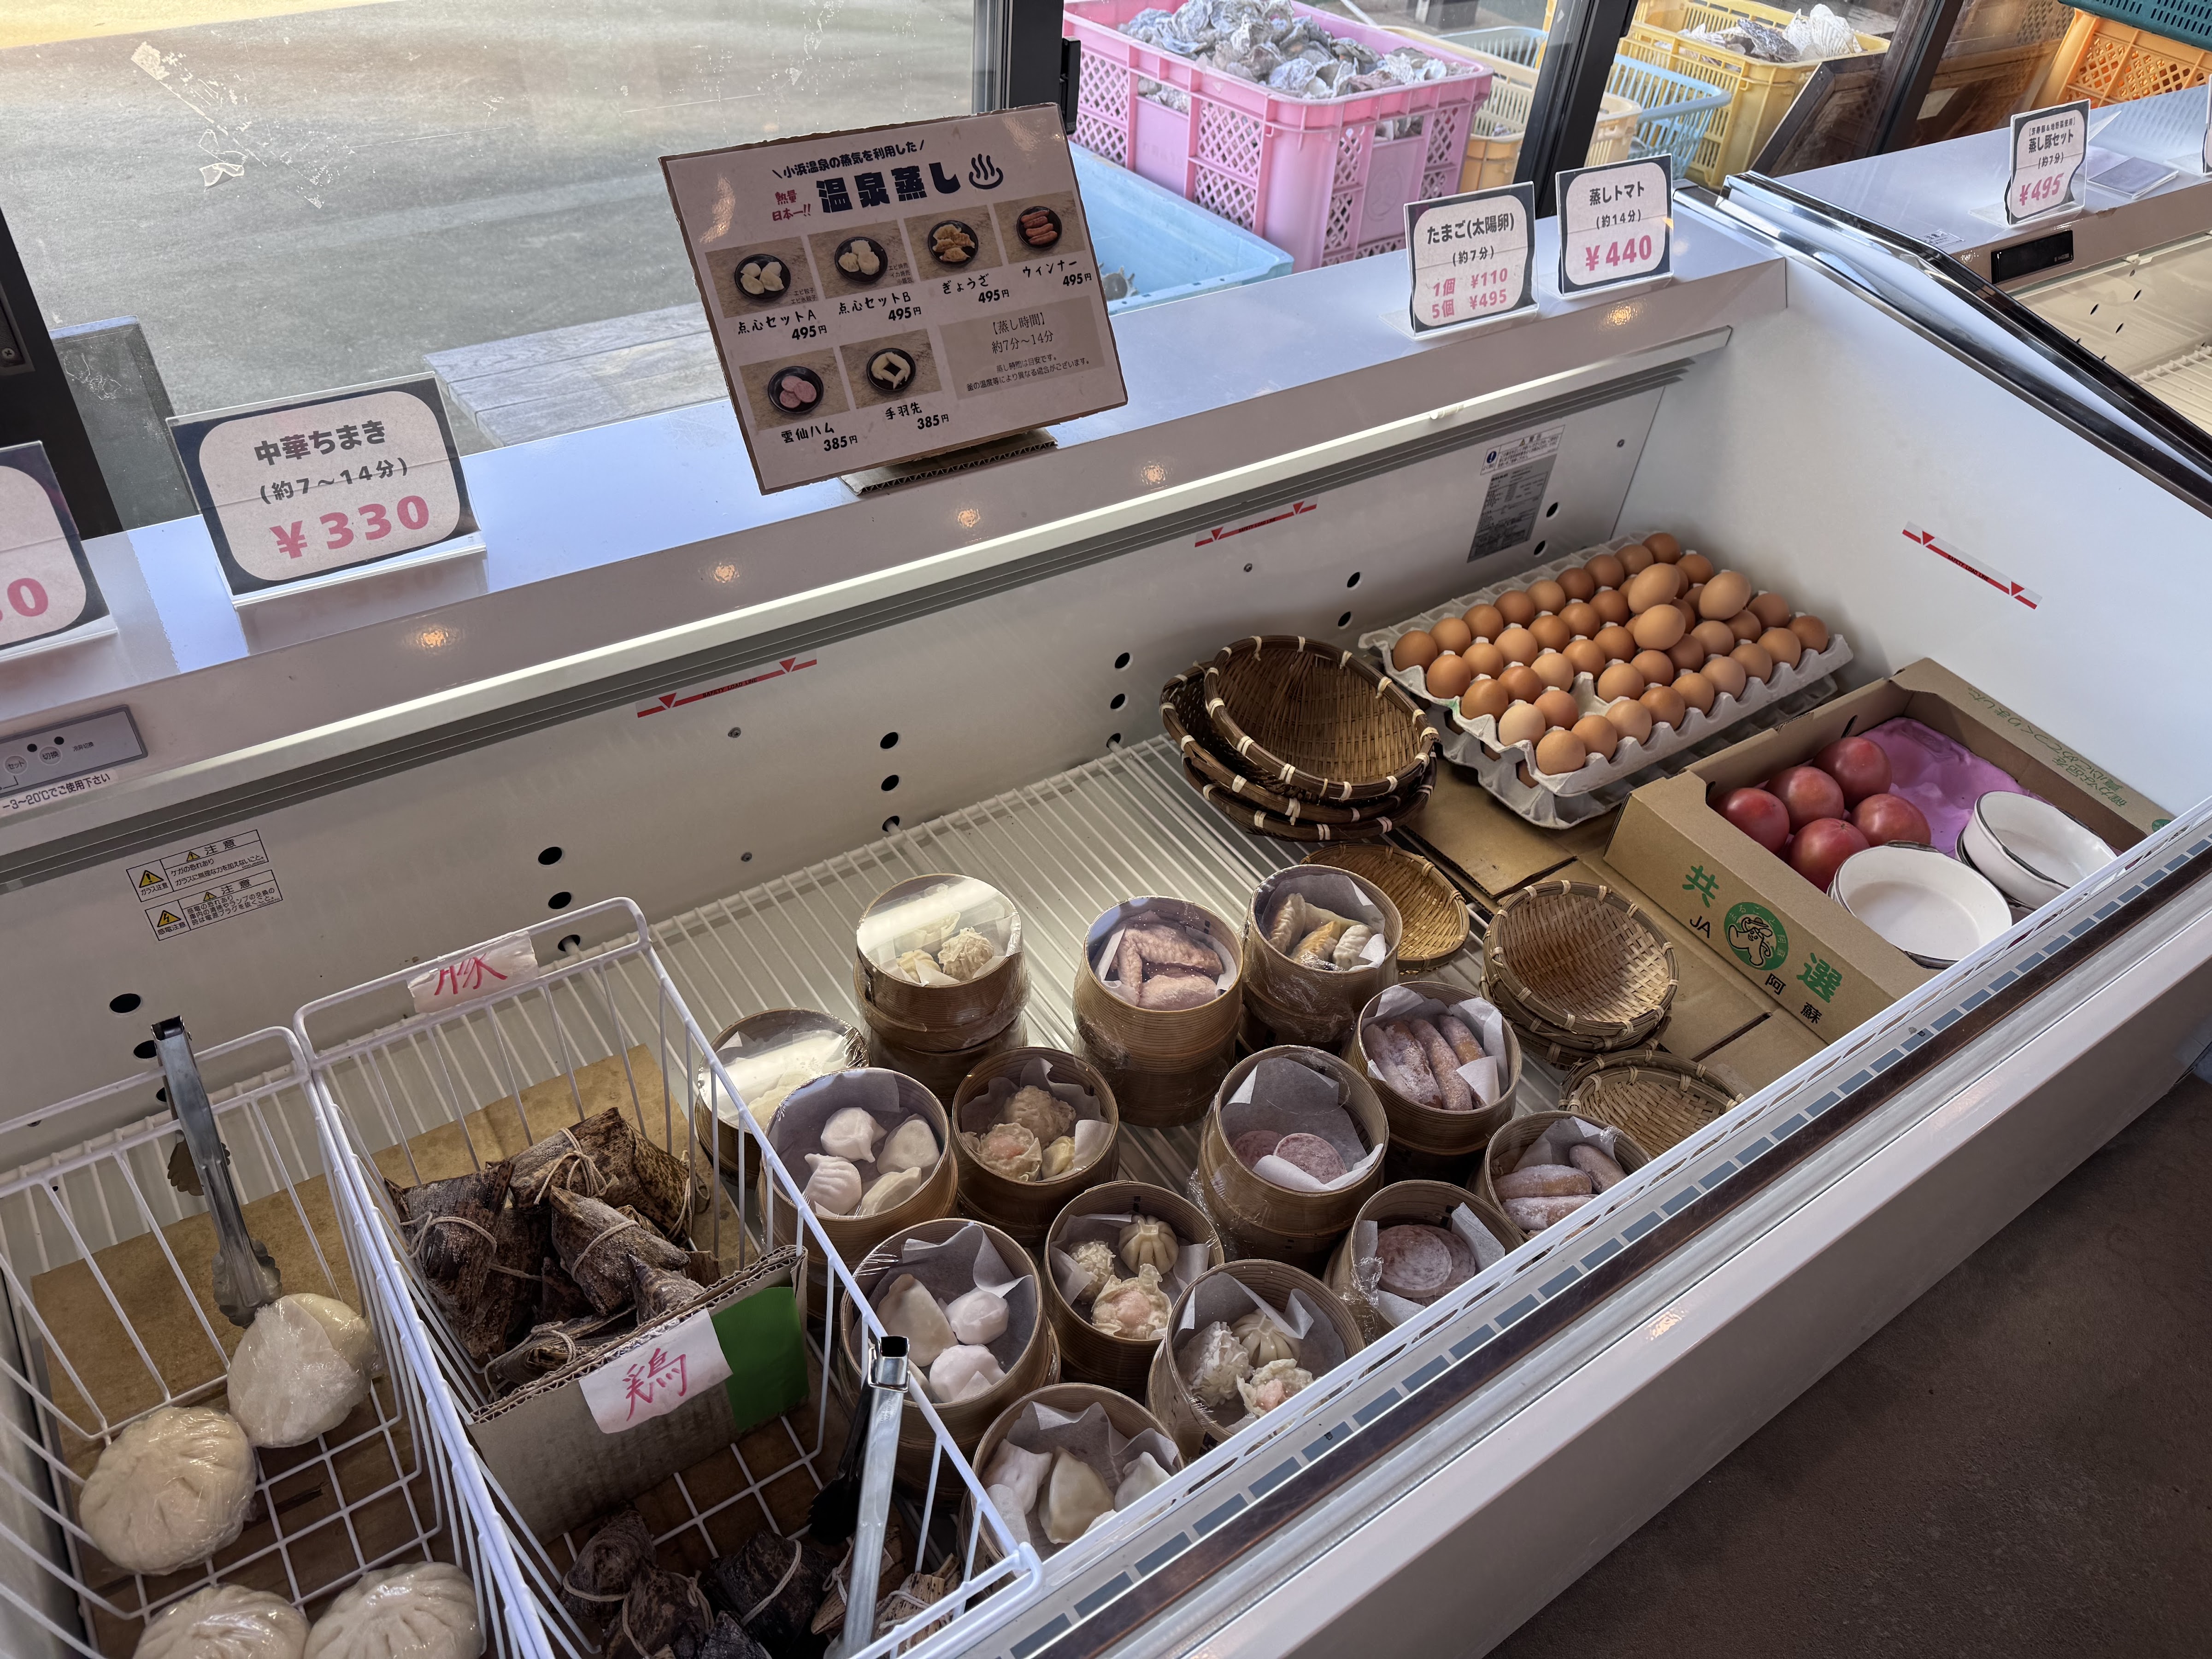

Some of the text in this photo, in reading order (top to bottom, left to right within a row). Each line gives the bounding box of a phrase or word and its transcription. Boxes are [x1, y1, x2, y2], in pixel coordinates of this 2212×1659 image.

[2029, 129, 2074, 153] 蒸し豚セット
[2038, 152, 2064, 169] (約7分)
[775, 189, 798, 206] 熱量
[816, 162, 961, 213] 温泉蒸し
[1589, 181, 1645, 206] 蒸しトマト
[2019, 172, 2065, 206] ¥495
[1427, 213, 1515, 245] たまご(太陽卵)
[1596, 209, 1641, 230] (約14分)
[1453, 245, 1494, 266] (約7分)
[1585, 235, 1653, 271] ¥440
[1023, 260, 1077, 277] ウィンナー
[942, 273, 990, 294] ぎょうざ
[1063, 273, 1092, 286] 495円
[1433, 268, 1509, 297] 1個 ¥110
[839, 291, 911, 315] 点心セットB
[978, 289, 1010, 303] 495円
[1432, 289, 1507, 319] 5個 ¥495
[738, 310, 817, 335] 点心セットA
[888, 306, 922, 321] 495円
[792, 325, 827, 340] 495円
[996, 354, 1057, 374] 蒸し時間は目安です。
[885, 401, 923, 420] 手羽先
[917, 414, 949, 430] 385円
[254, 420, 386, 466] 中華ちまき
[781, 422, 835, 444] 雲仙ハム
[824, 435, 858, 452] 385円
[269, 495, 430, 559] ¥330
[1965, 565, 1978, 575] LOAD
[0, 577, 49, 621] 0
[702, 688, 725, 698] SAFETY
[727, 682, 743, 691] LOAD
[7, 760, 25, 770] セット
[42, 750, 60, 760] 切換
[2052, 756, 2127, 808] 確かな品を
[204, 839, 236, 856] 注意
[171, 858, 214, 877] ケガの恐れあり
[175, 854, 264, 887] ガラスに無理な力を加えないこと。
[140, 882, 169, 896] ガラス注意
[221, 879, 252, 895] 注意
[187, 895, 234, 914] 感電の恐れあり
[157, 921, 187, 935] 感電注意
[1682, 865, 1843, 1003] 共 選
[1689, 915, 1711, 939] JA
